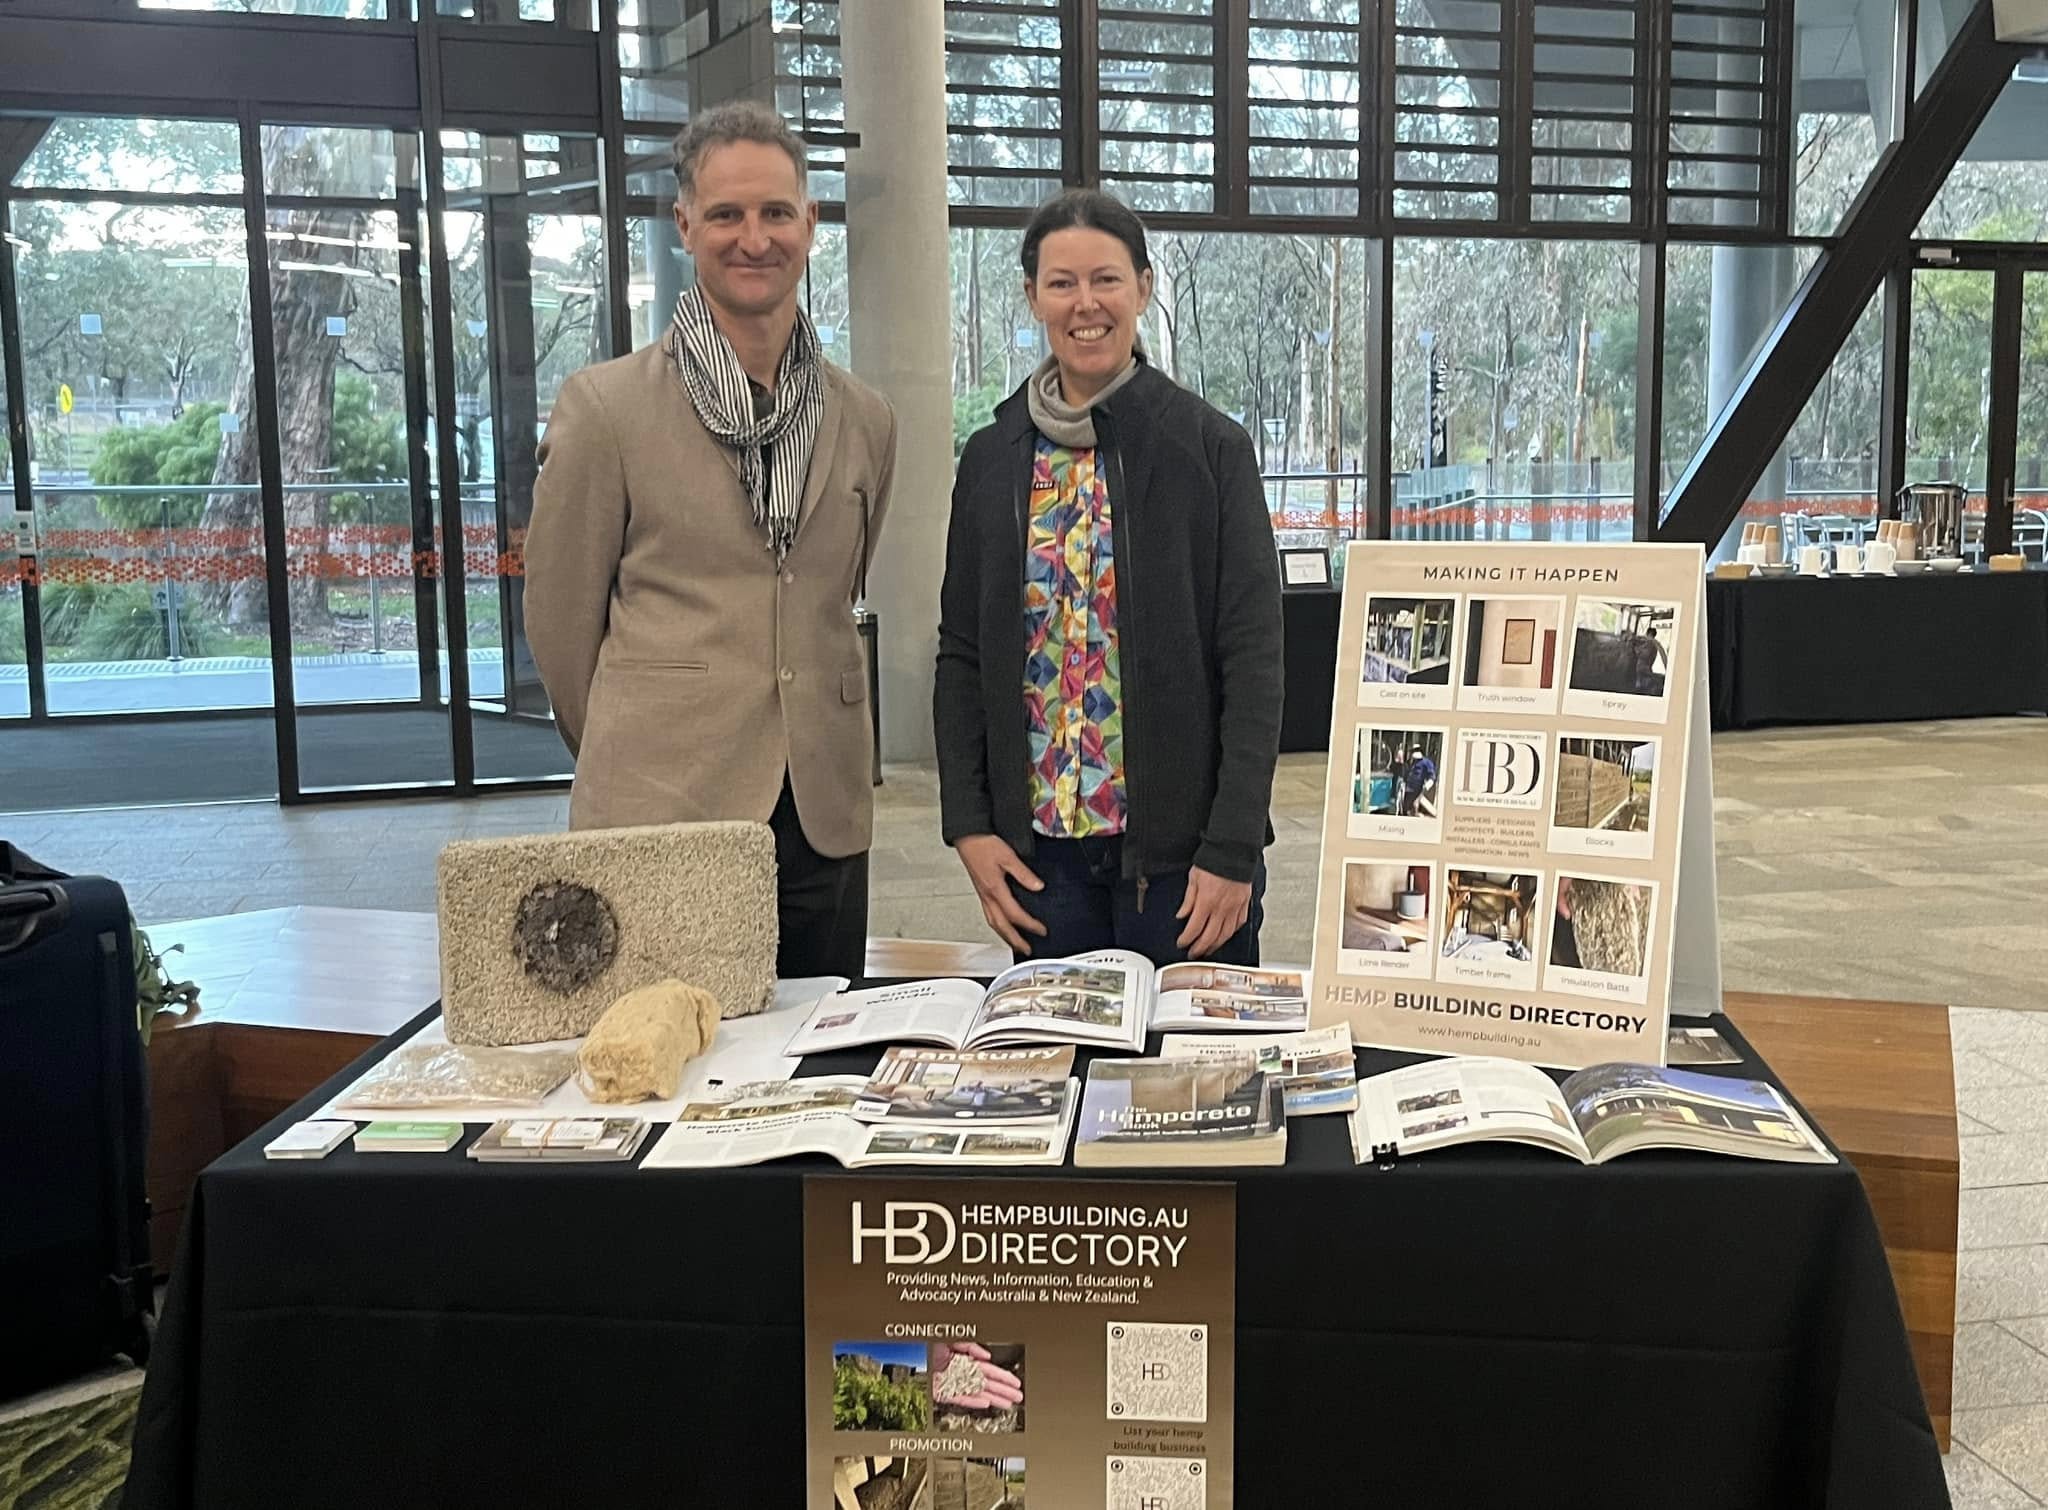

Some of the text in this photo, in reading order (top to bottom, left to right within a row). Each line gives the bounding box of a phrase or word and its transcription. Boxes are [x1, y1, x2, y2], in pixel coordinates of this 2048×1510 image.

[1423, 566, 1619, 582] MAKING IT HAPPEN
[1379, 689, 1427, 700] Cast on site
[1478, 693, 1537, 704] Truth window
[1602, 699, 1627, 710] Spray
[1378, 823, 1405, 836] Mixing
[1585, 837, 1615, 848] Blocks
[1359, 958, 1410, 970] Lime Render
[1455, 966, 1512, 980] Timber frame
[1561, 976, 1630, 993] Insulation Batts
[1325, 984, 1648, 1034] HEMP BUILDING DIRECTORY
[1417, 1023, 1542, 1049] www.hempbuilding.au
[898, 1049, 1061, 1062] Sanctuary
[961, 1204, 1189, 1229] HEMPBUILDING.AU
[851, 1200, 957, 1265] HBD
[961, 1231, 1188, 1267] DIRECTORY
[886, 1271, 1154, 1289] Providing News, Information, Education &
[899, 1288, 1140, 1304] Advocacy in Australia & New Zealand.
[885, 1323, 977, 1337] CONNECTION
[1123, 1426, 1204, 1440] List your hemp
[889, 1438, 973, 1452] PROMOTION
[1113, 1440, 1206, 1453] building business
